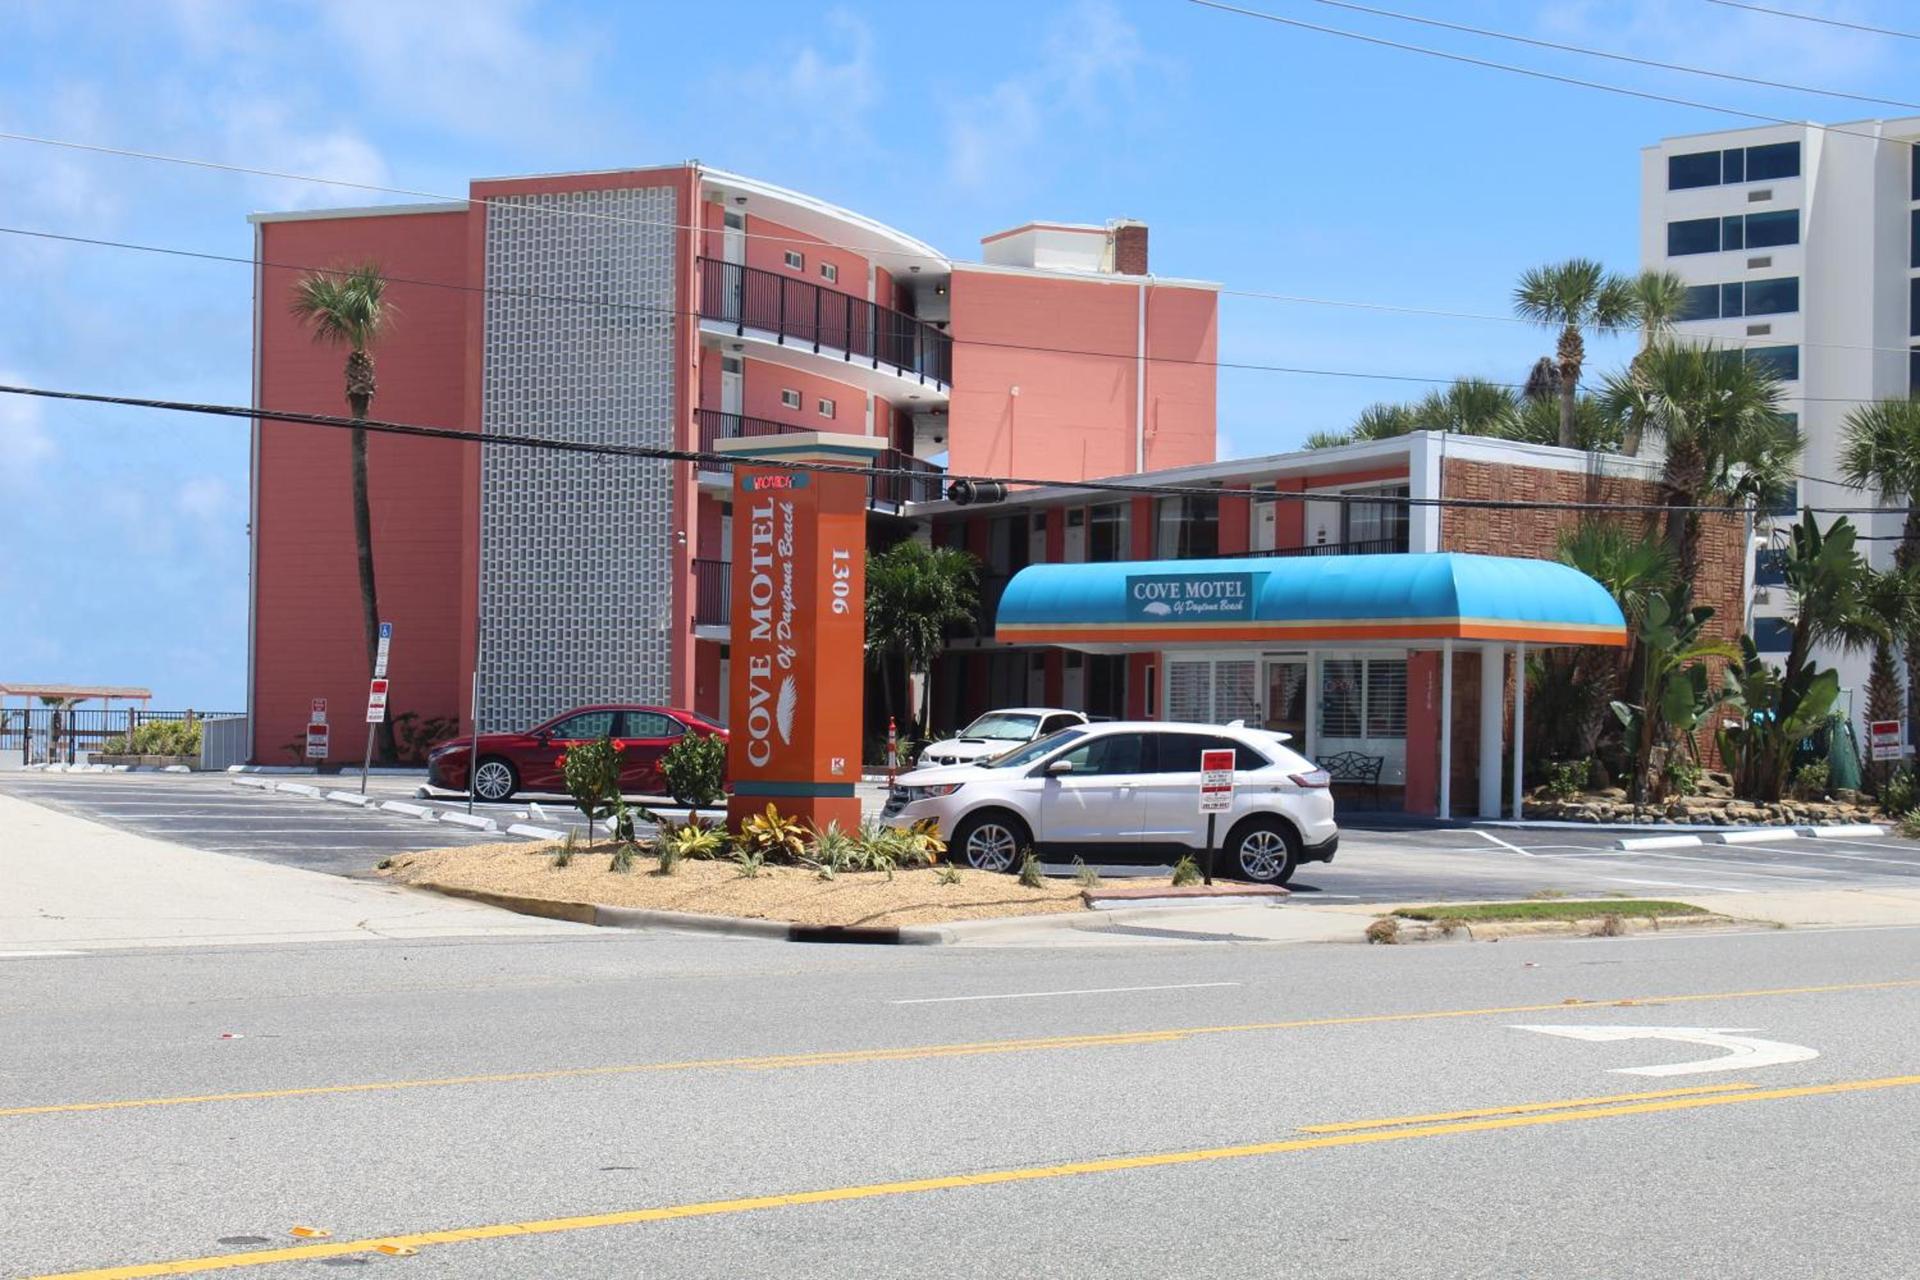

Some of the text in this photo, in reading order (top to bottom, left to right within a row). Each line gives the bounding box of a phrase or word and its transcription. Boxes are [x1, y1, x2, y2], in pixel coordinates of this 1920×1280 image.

[777, 501, 796, 669] Of Daytona Beach
[832, 547, 850, 615] 1306
[1134, 581, 1246, 600] COVE MOTEL
[1173, 599, 1244, 614] Of Daytona Beach
[748, 497, 774, 767] COVE MOTEL
